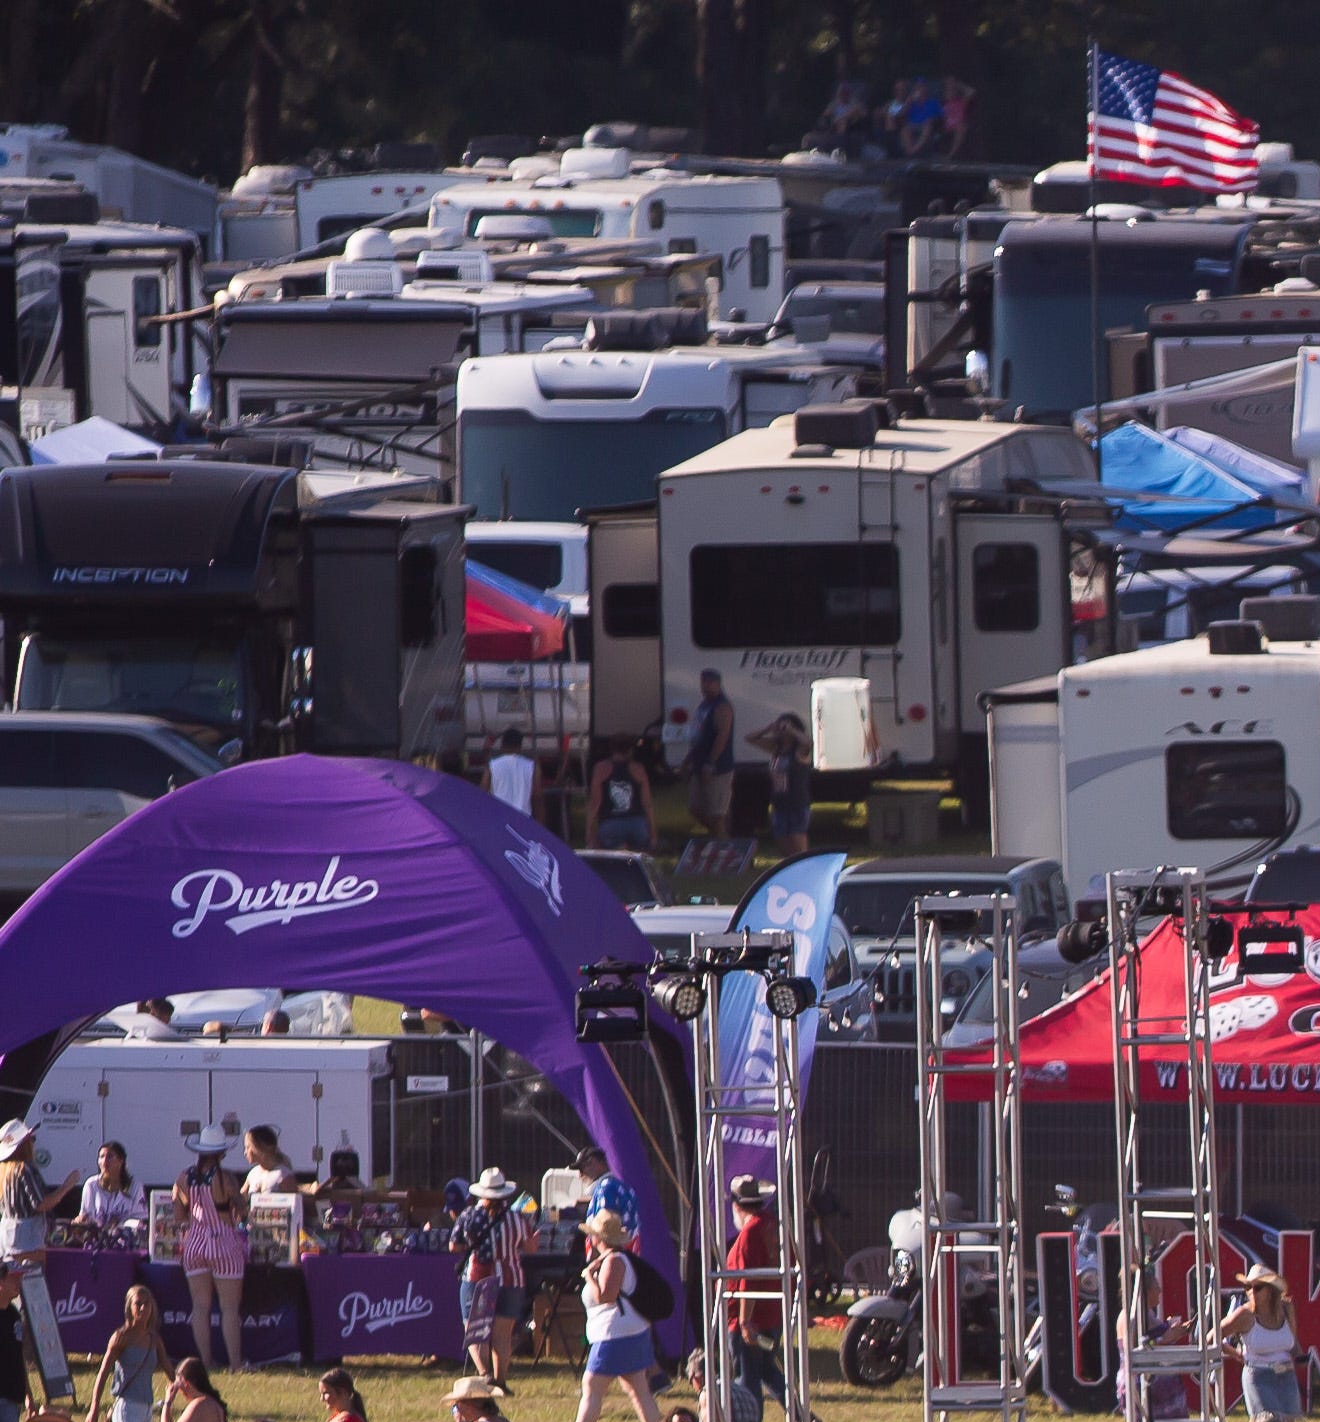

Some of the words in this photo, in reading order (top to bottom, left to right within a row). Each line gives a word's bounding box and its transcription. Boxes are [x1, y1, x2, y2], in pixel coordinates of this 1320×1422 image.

[52, 567, 190, 583] INCEPTION
[741, 647, 852, 670] Flagstaff
[171, 855, 379, 938] Purple
[339, 1280, 433, 1339] Purple
